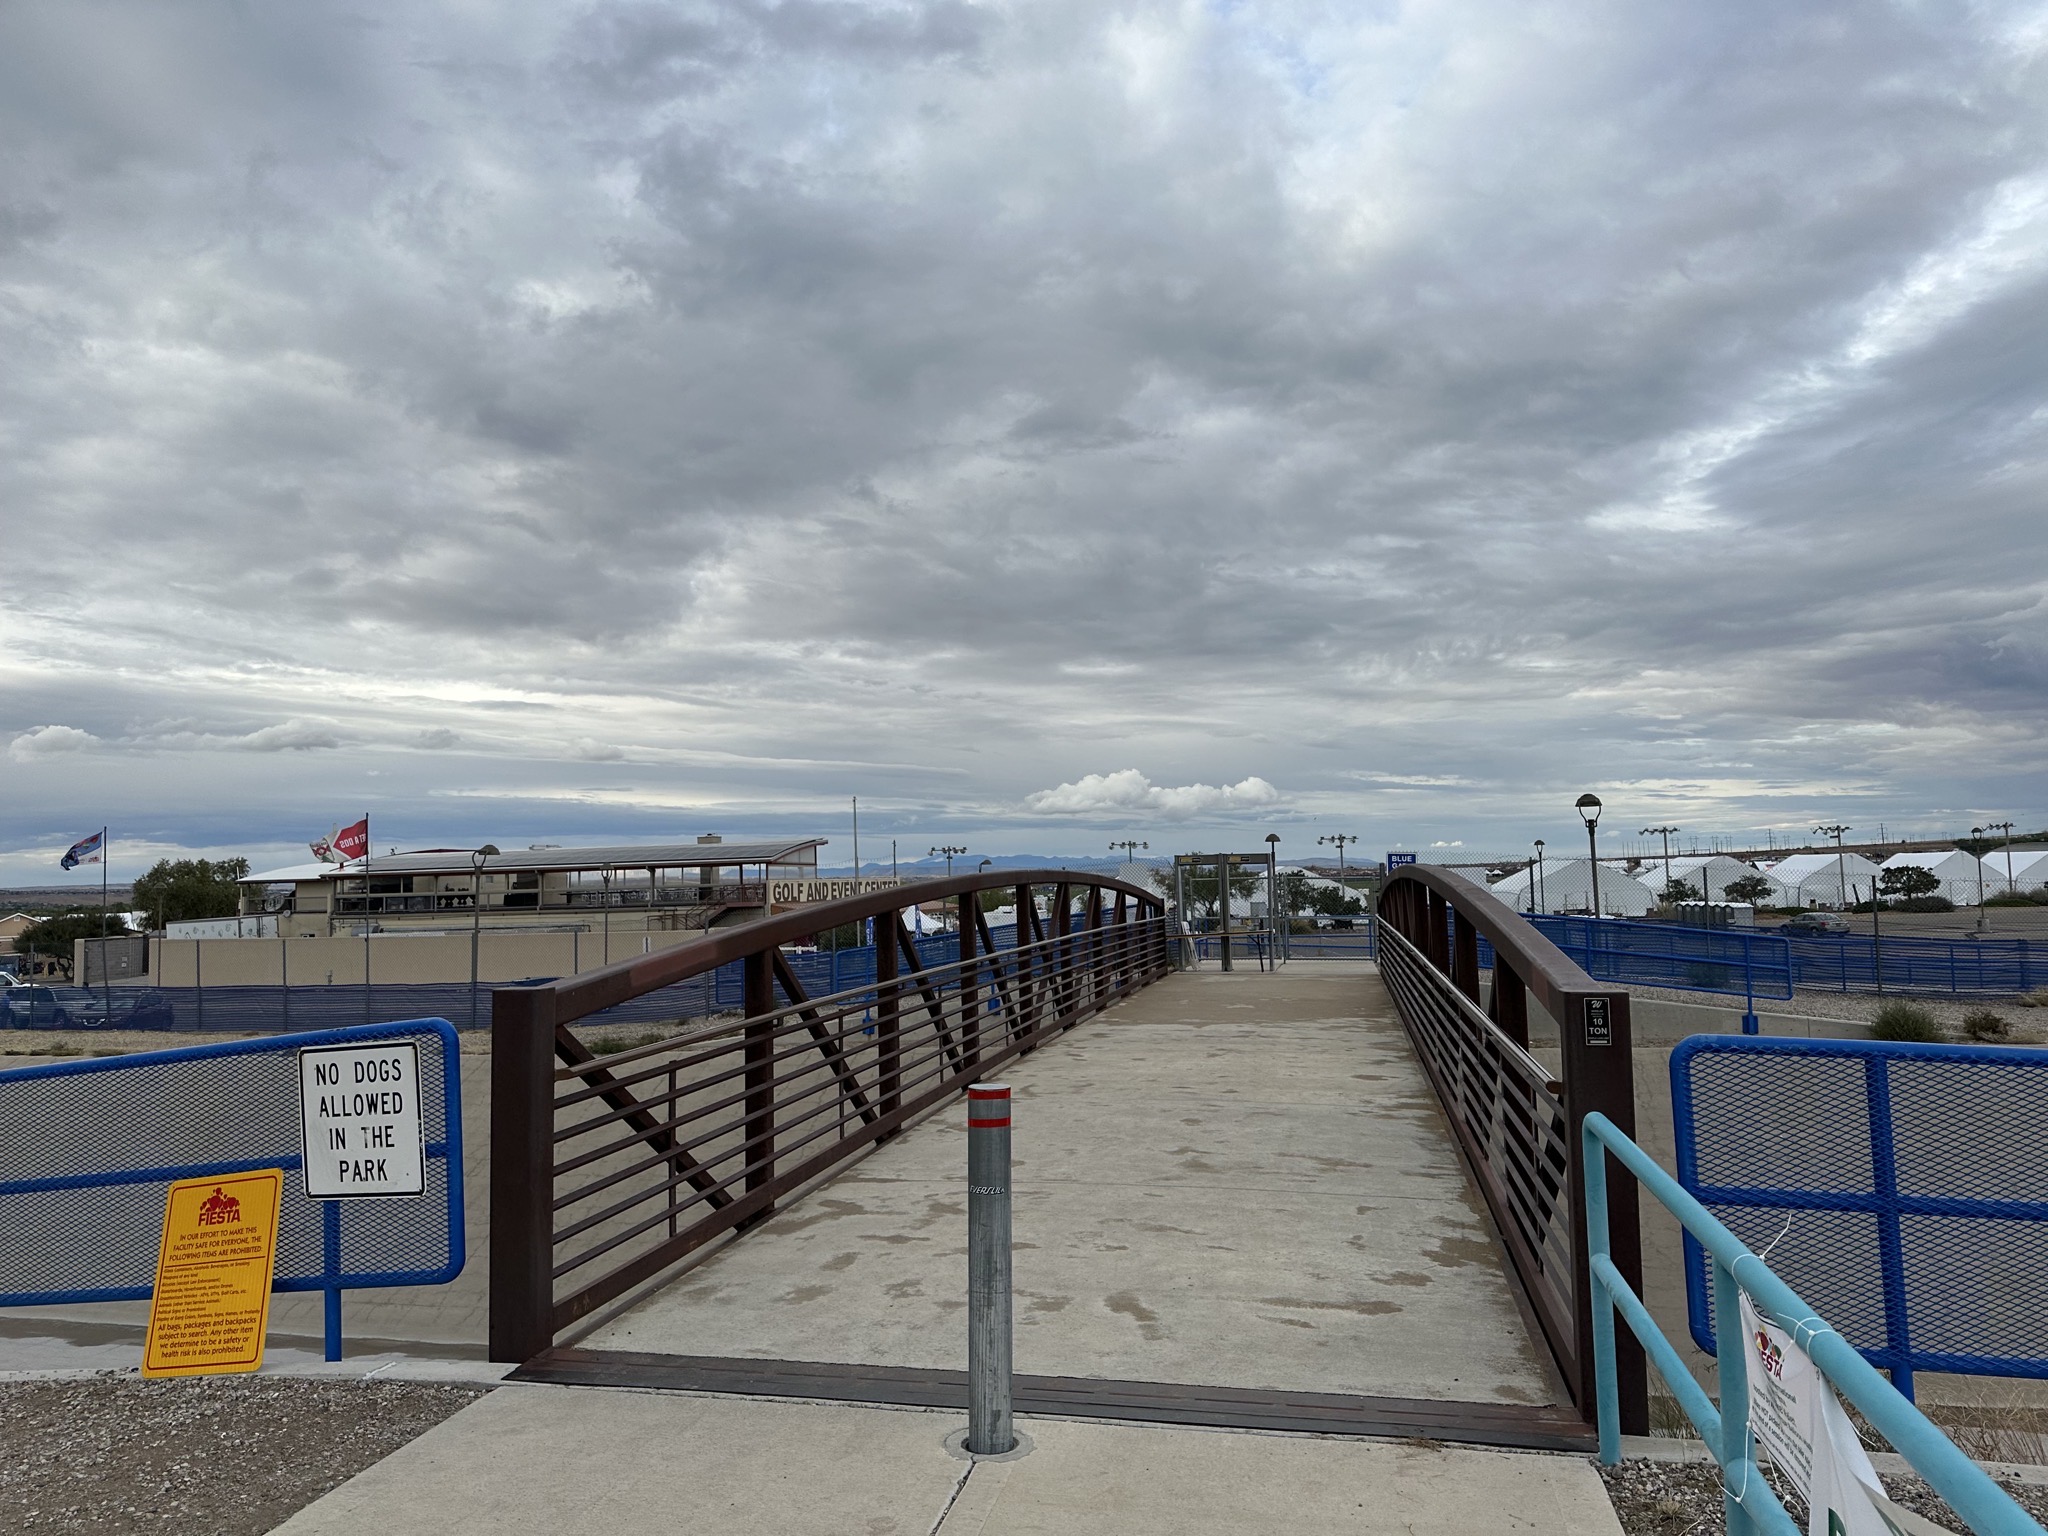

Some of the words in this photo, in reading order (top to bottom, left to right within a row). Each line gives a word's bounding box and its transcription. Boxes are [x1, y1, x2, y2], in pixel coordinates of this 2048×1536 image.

[773, 882, 804, 903] GOLF
[806, 882, 829, 902] AND
[1588, 1027, 1608, 1035] TON
[316, 1063, 339, 1085] NO
[354, 1059, 401, 1083] DOGS
[320, 1092, 402, 1117] ALLOWED
[329, 1127, 346, 1150] IN
[361, 1125, 394, 1148] THE
[339, 1159, 388, 1182] PARK
[198, 1209, 241, 1227] FIESTA
[187, 1232, 199, 1240] OUR
[200, 1230, 219, 1238] EFFORT
[229, 1228, 243, 1236] MAKE
[246, 1226, 257, 1234] THIS
[173, 1243, 194, 1251] FACILITY
[221, 1237, 249, 1246] EVERYONE,
[169, 1252, 200, 1261] FOLLOWING
[202, 1250, 217, 1258] ITEMS
[167, 1322, 182, 1331] bags,
[184, 1320, 211, 1330] packages
[225, 1316, 256, 1326] backpacks
[158, 1332, 179, 1341] subject
[170, 1340, 199, 1348] determine
[223, 1337, 241, 1345] safety
[162, 1350, 179, 1358] health
[212, 1346, 244, 1355] prohibited.
[1758, 1350, 1784, 1381] ESTA
